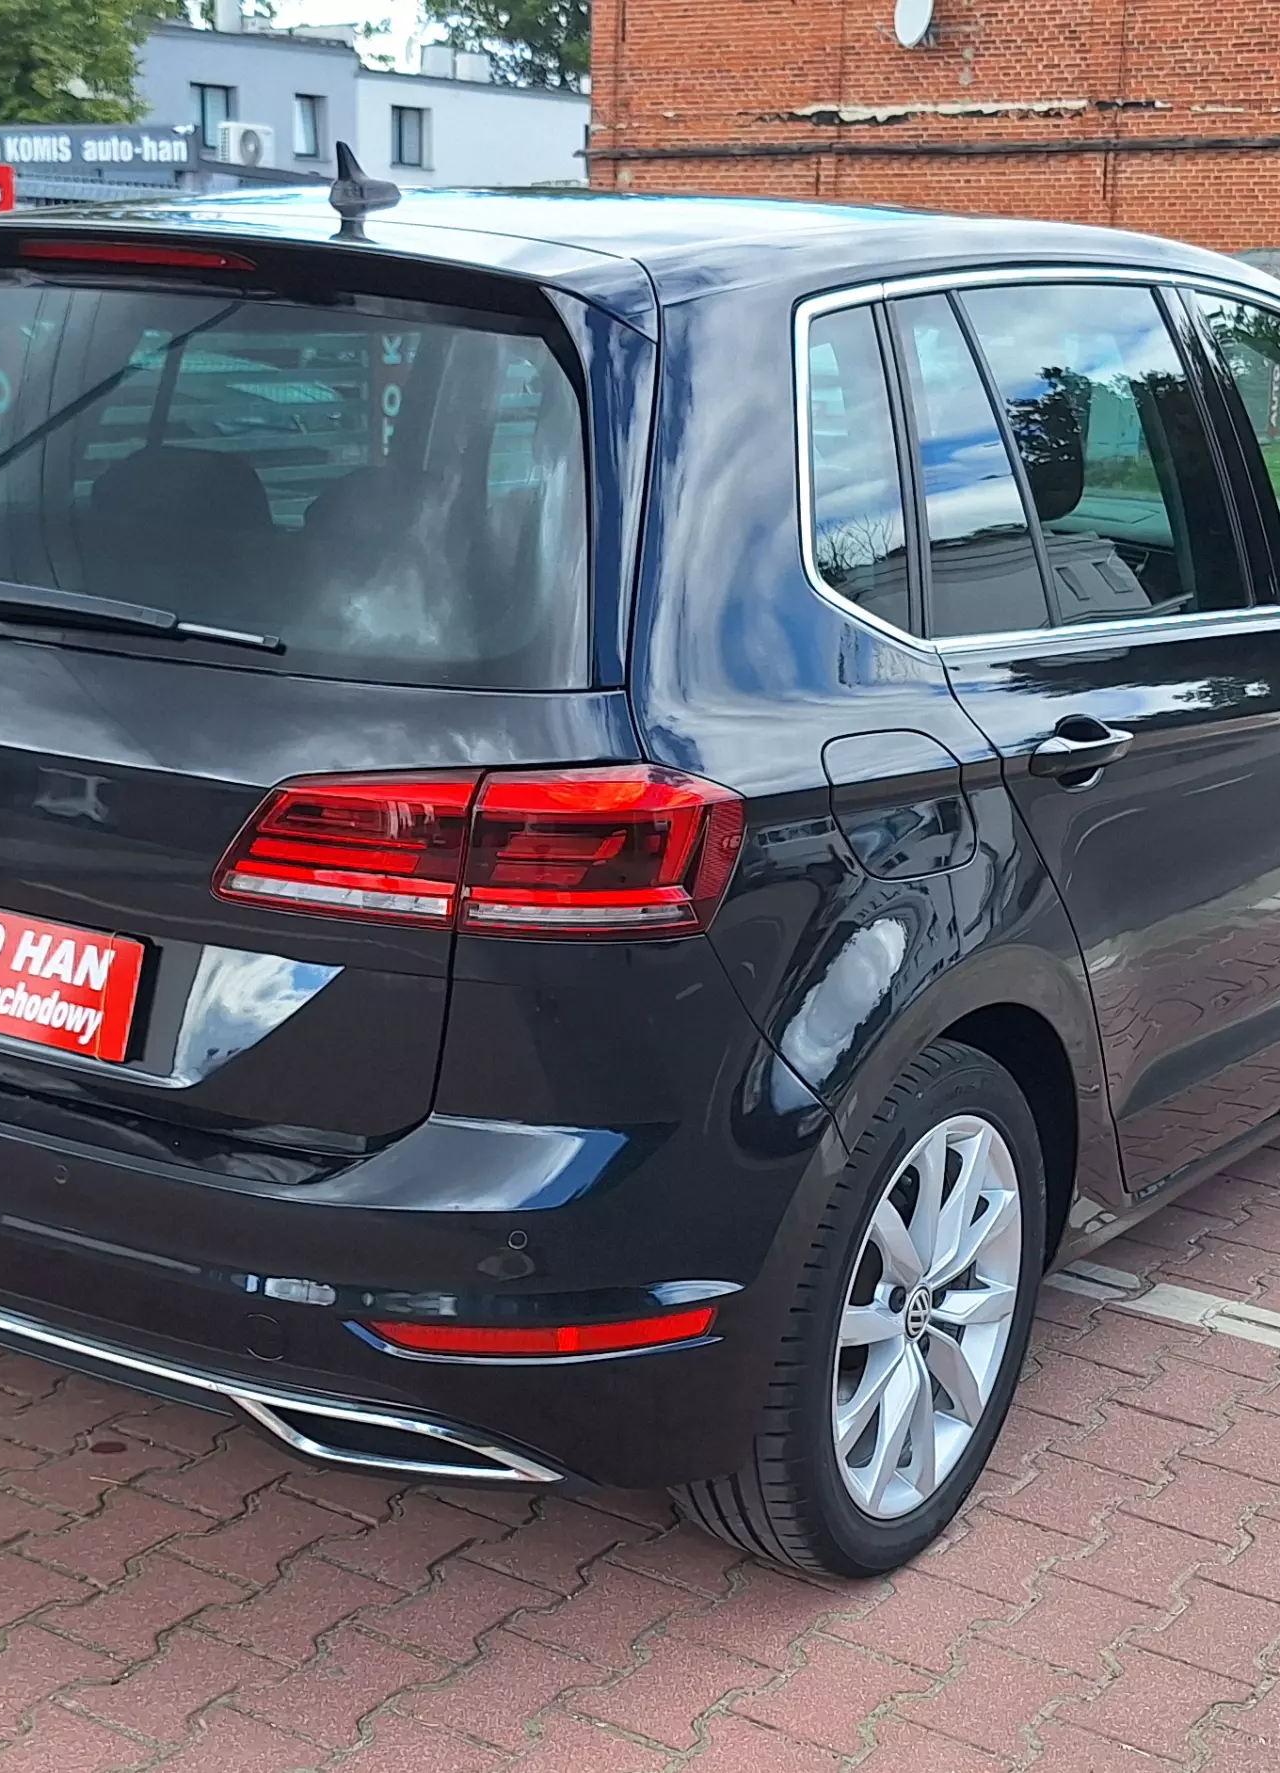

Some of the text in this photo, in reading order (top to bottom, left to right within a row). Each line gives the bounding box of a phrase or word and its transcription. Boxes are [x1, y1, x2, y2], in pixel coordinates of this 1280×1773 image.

[6, 134, 71, 163] KOMIS
[82, 133, 188, 162] auto-han
[10, 929, 116, 993] HAN
